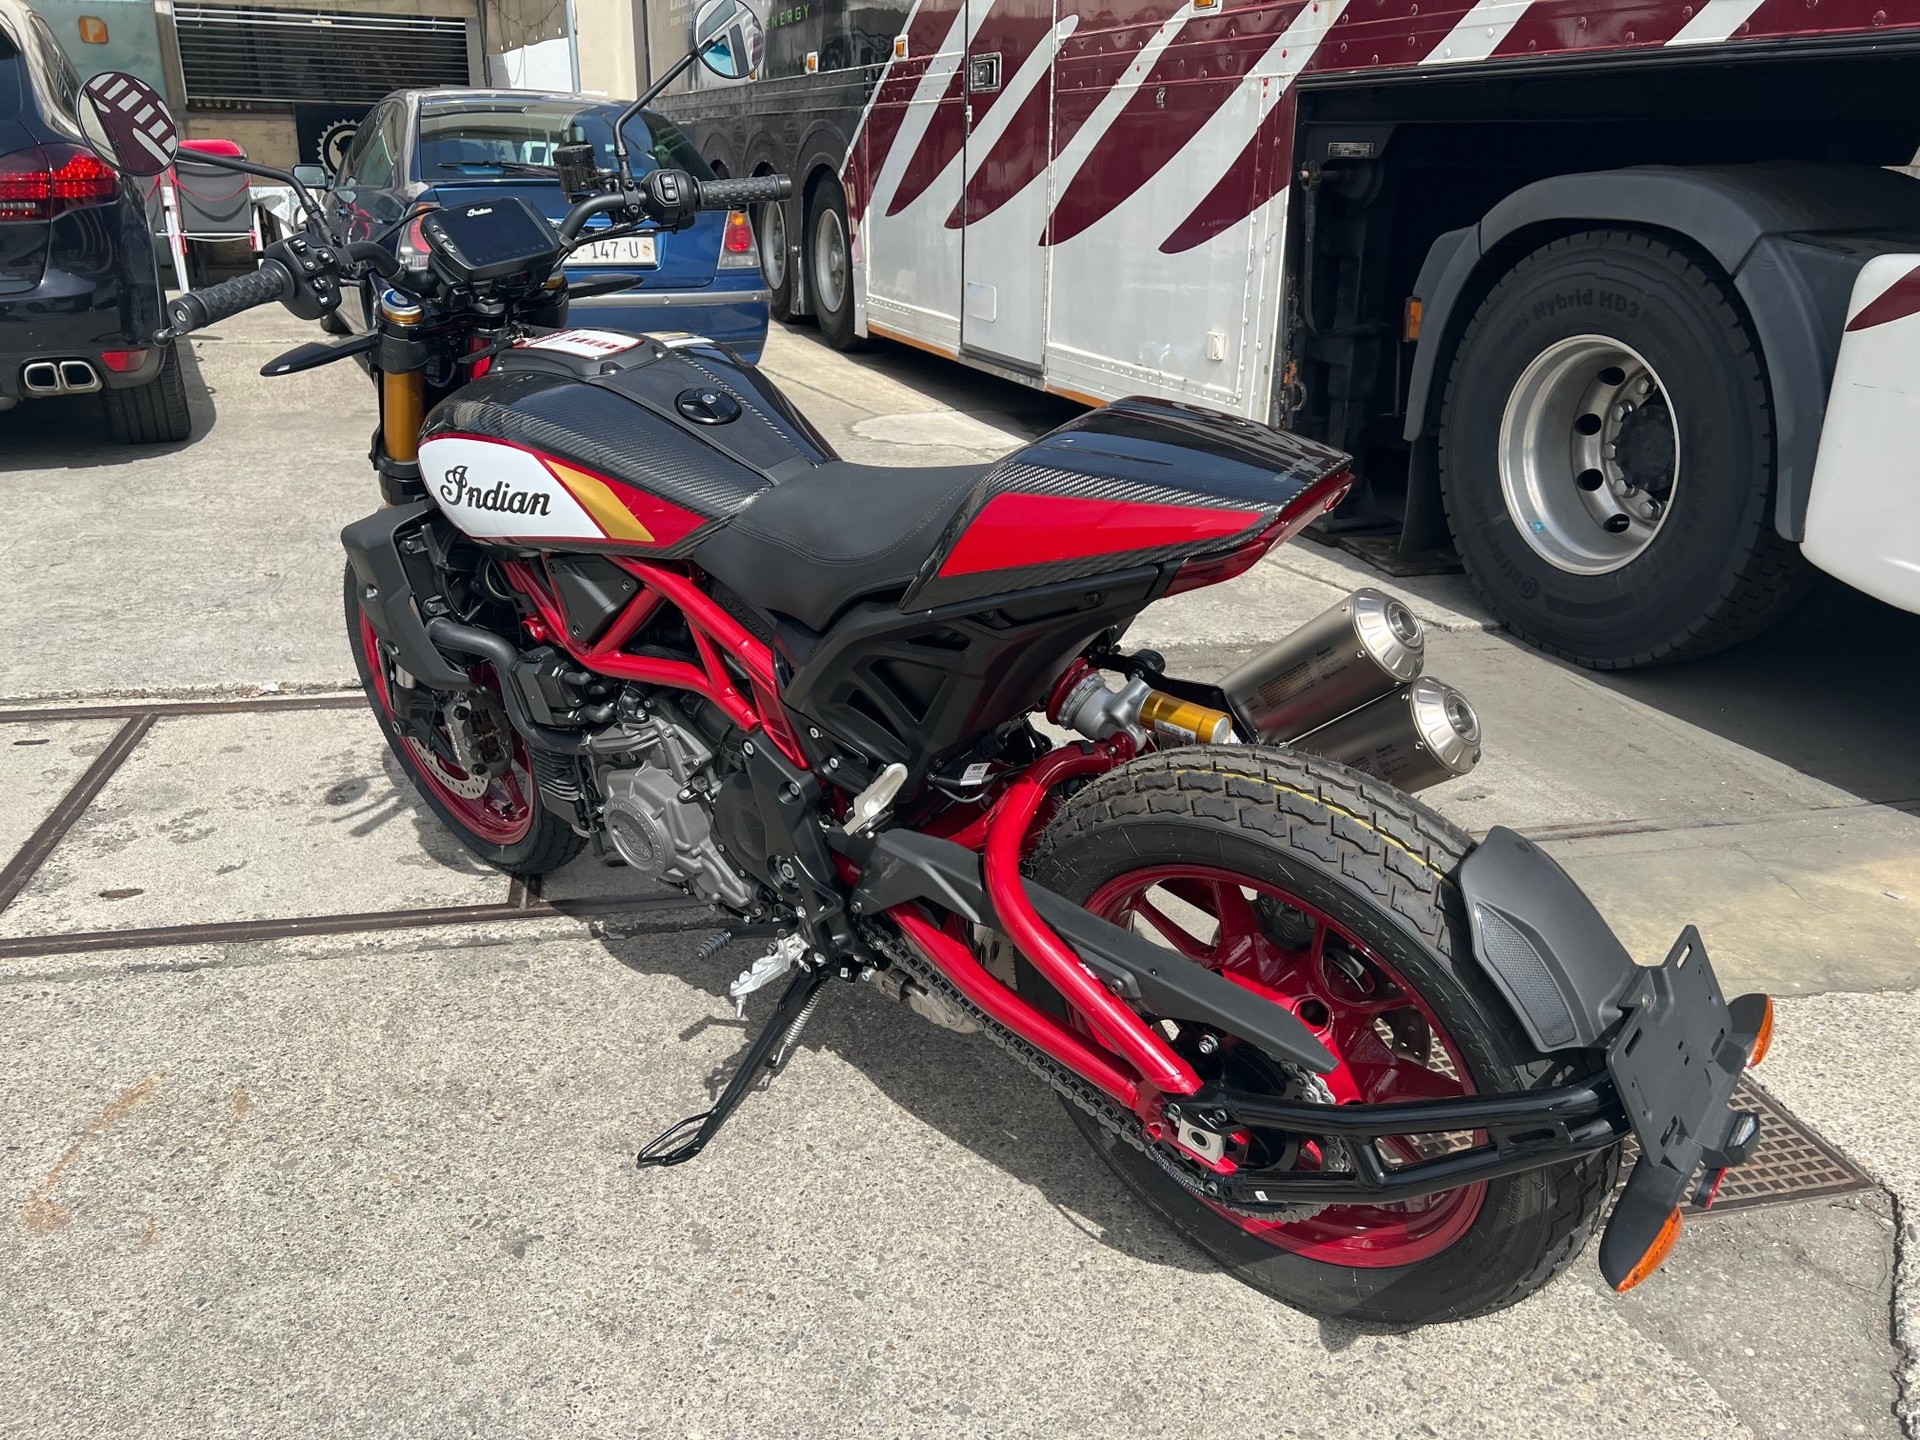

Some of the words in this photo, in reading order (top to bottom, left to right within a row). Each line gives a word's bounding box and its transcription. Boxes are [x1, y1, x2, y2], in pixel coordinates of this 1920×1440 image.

[466, 207, 493, 217] Indian
[1532, 288, 1594, 320] Hybrid
[1600, 289, 1640, 319] HD3
[440, 465, 551, 516] Indian
